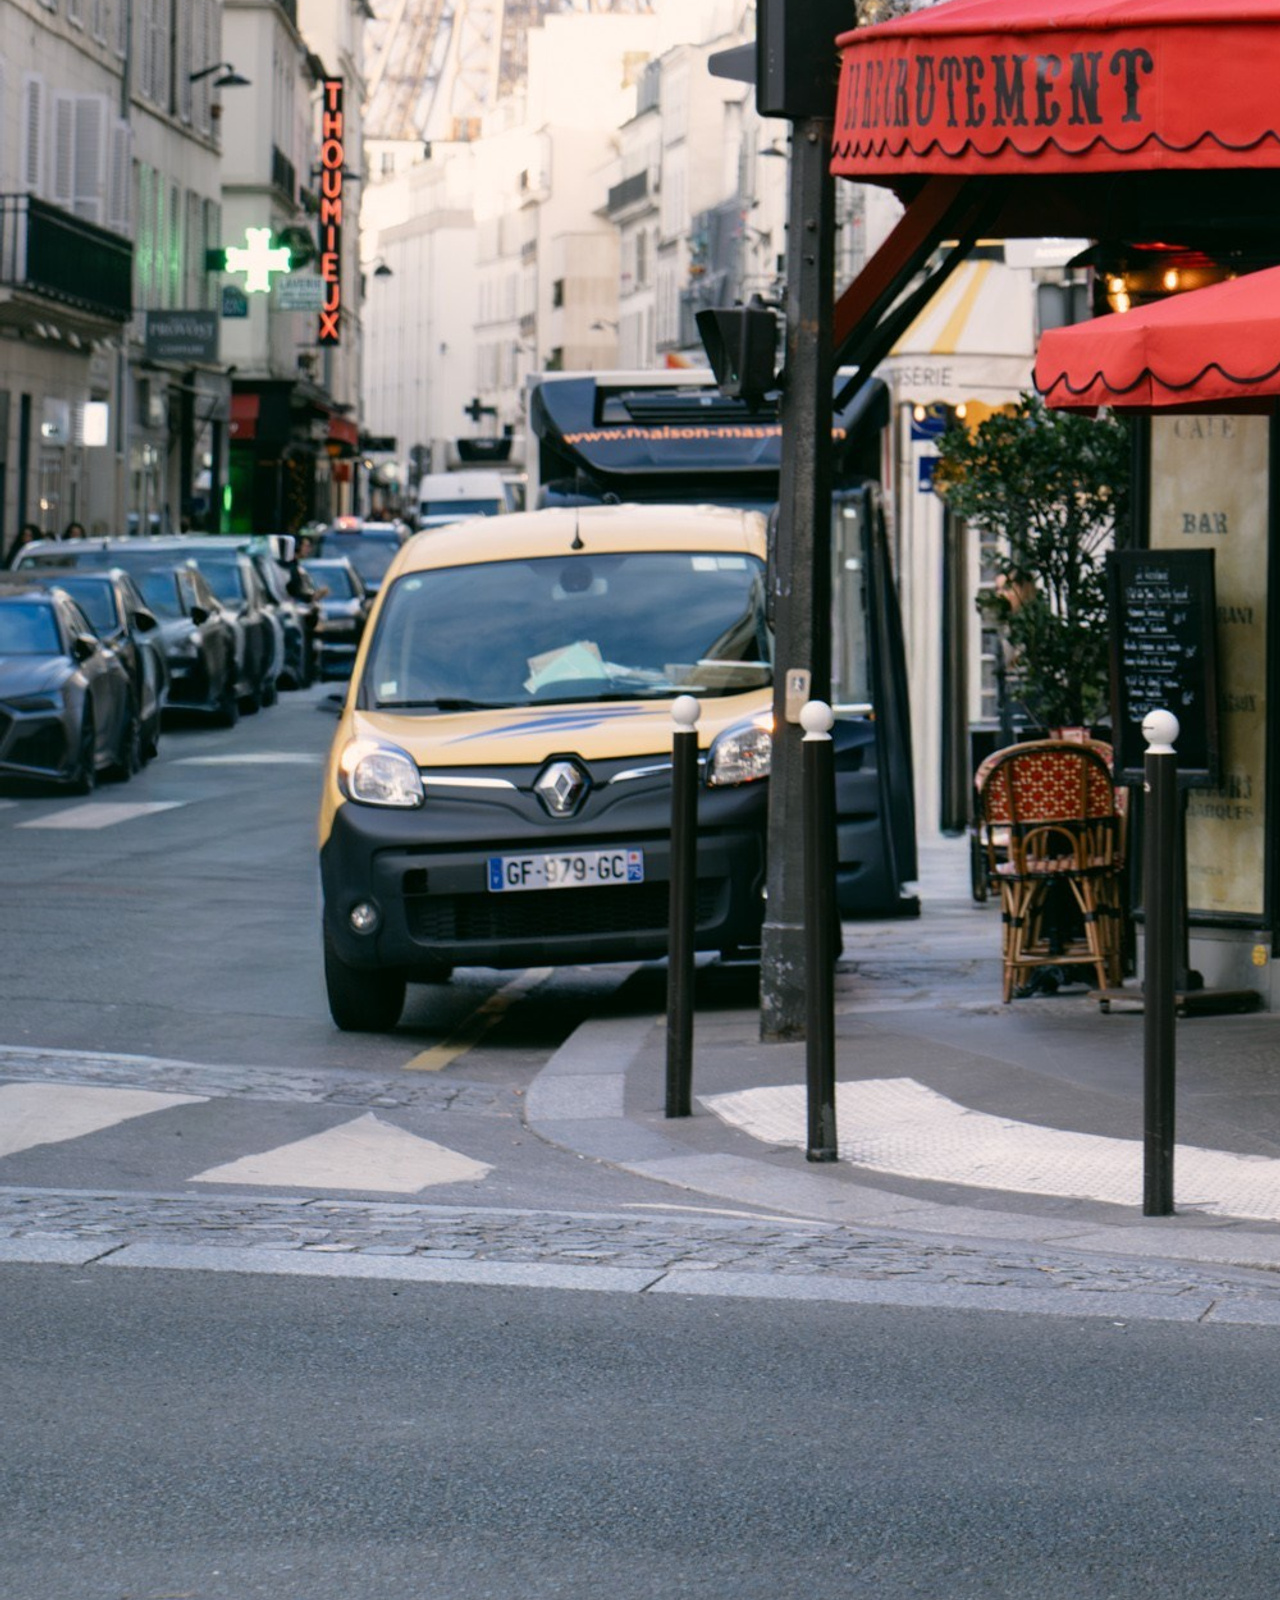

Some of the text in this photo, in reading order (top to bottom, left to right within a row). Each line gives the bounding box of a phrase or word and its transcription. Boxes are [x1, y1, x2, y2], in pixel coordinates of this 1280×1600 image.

[861, 47, 1154, 130] RECRUTEMENT
[319, 81, 344, 340] THOUMIEUX
[900, 365, 954, 387] SERIE
[1181, 511, 1229, 535] BAR
[506, 855, 625, 886] GF-979-GC
